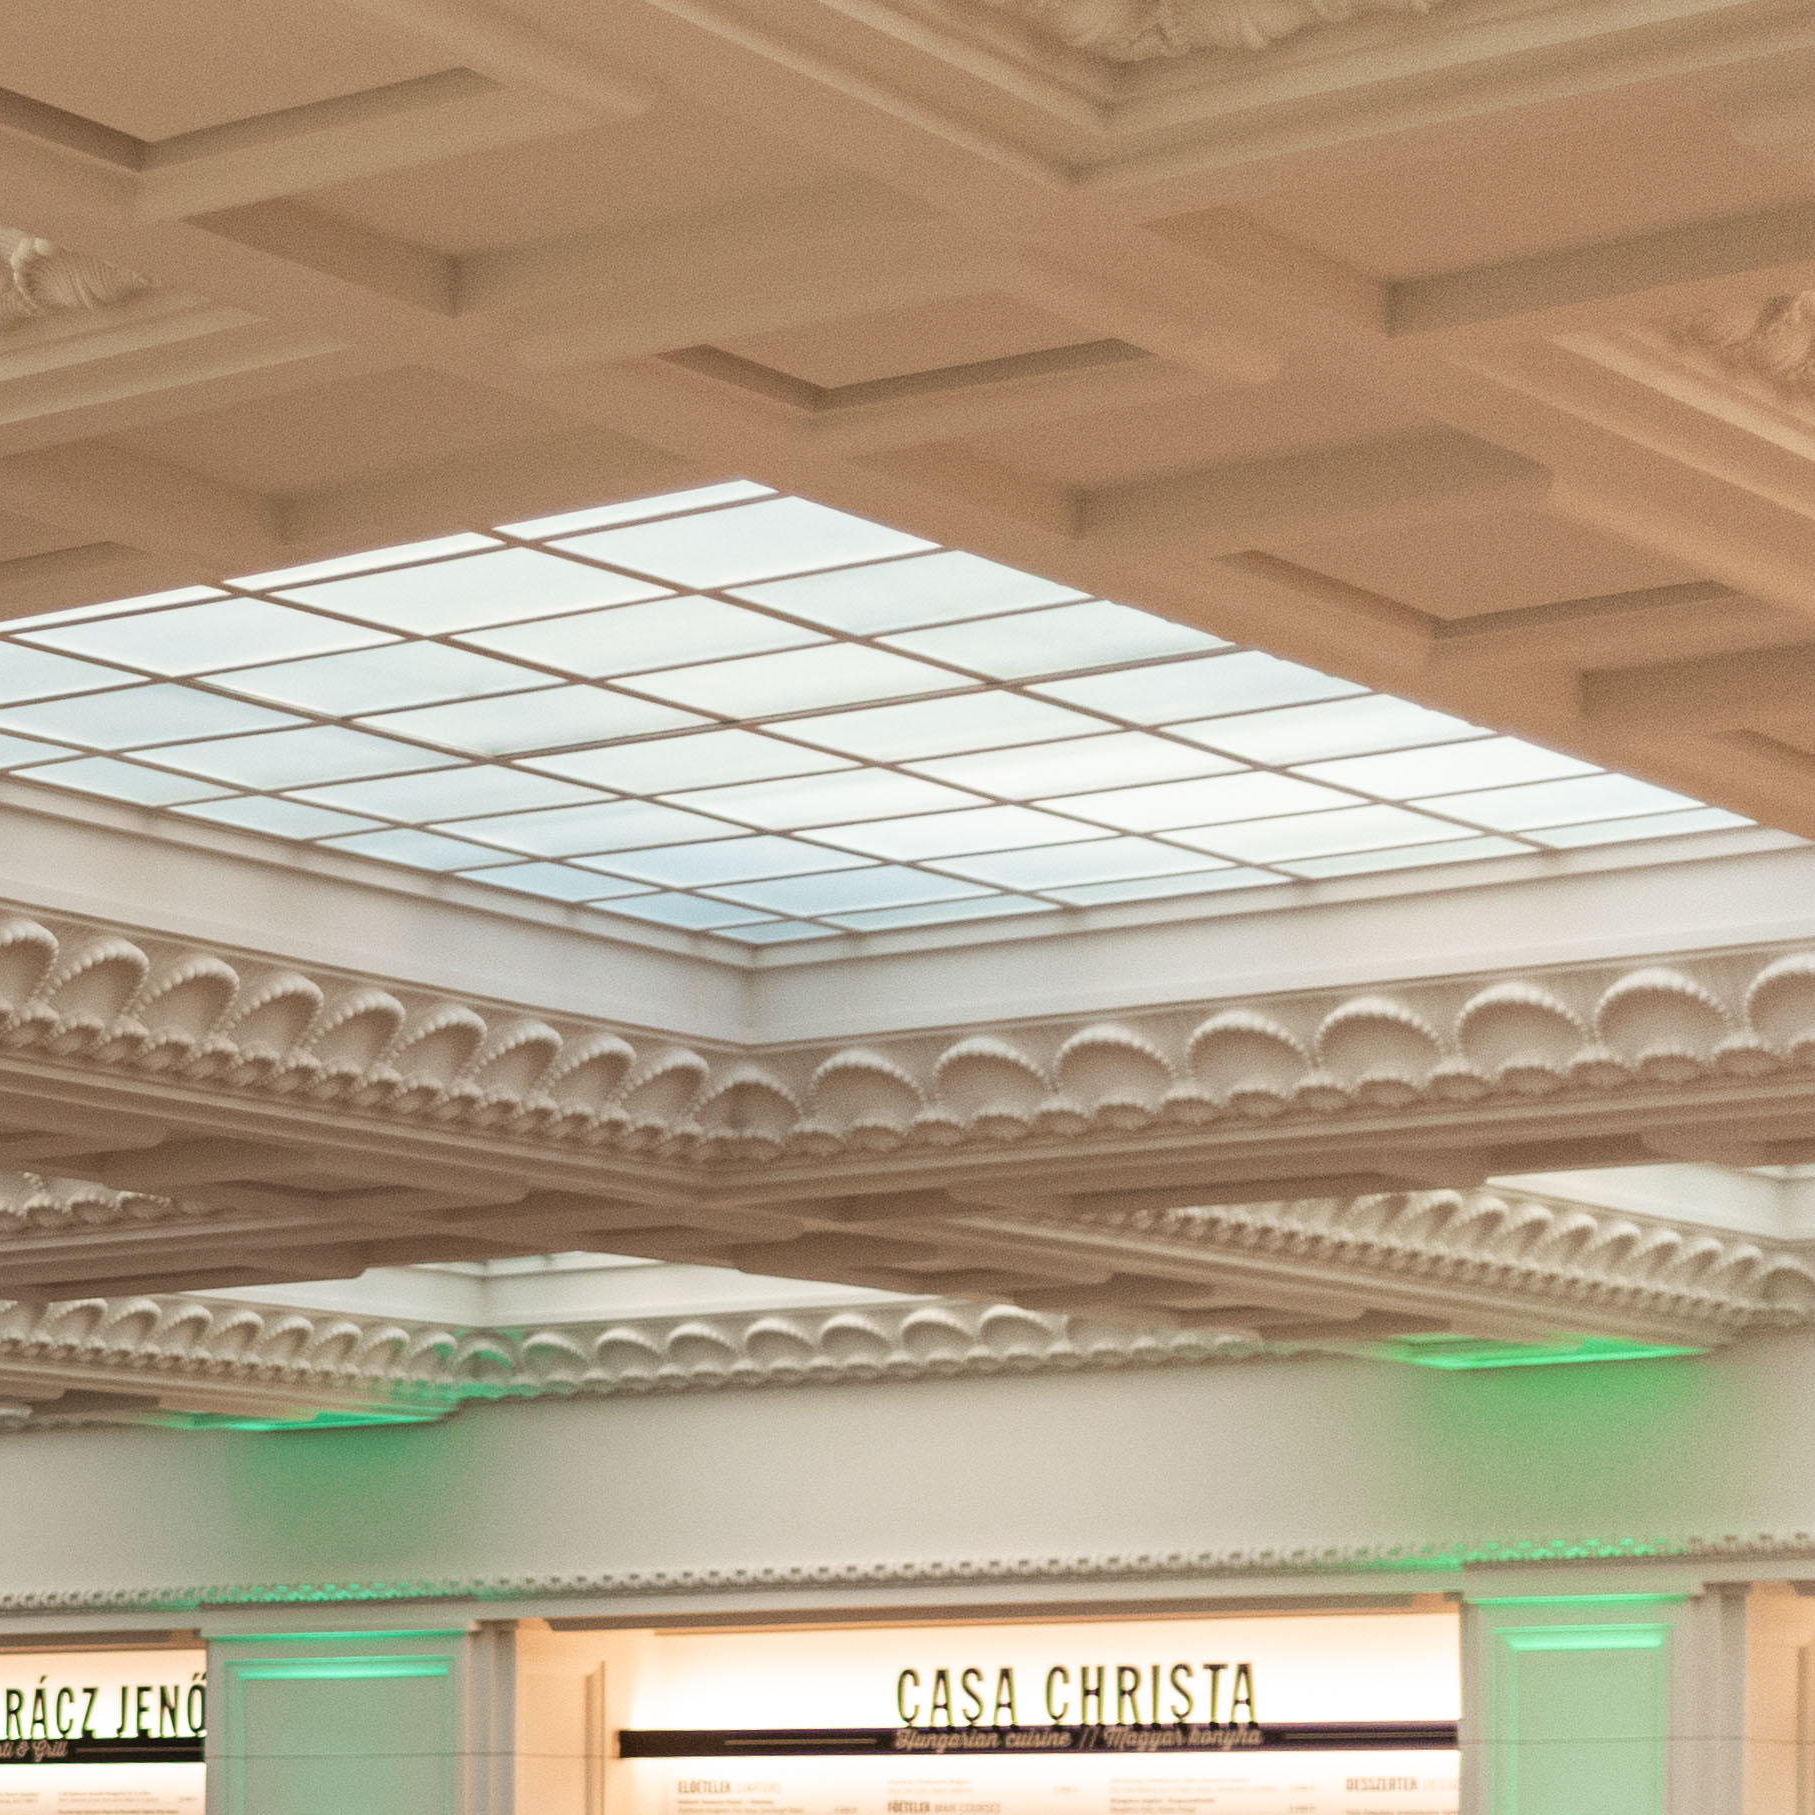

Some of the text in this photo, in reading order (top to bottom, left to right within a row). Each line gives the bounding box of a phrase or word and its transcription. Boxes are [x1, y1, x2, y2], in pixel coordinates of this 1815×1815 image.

[5, 1675, 99, 1740] RÁCZ
[897, 1663, 1258, 1728] CASA CHRISTA
[32, 1740, 69, 1763] Grill
[895, 1727, 999, 1752] Hungarian
[1001, 1732, 1070, 1749] cuisine
[1103, 1727, 1181, 1753] Magyar
[1189, 1726, 1264, 1752] konyha
